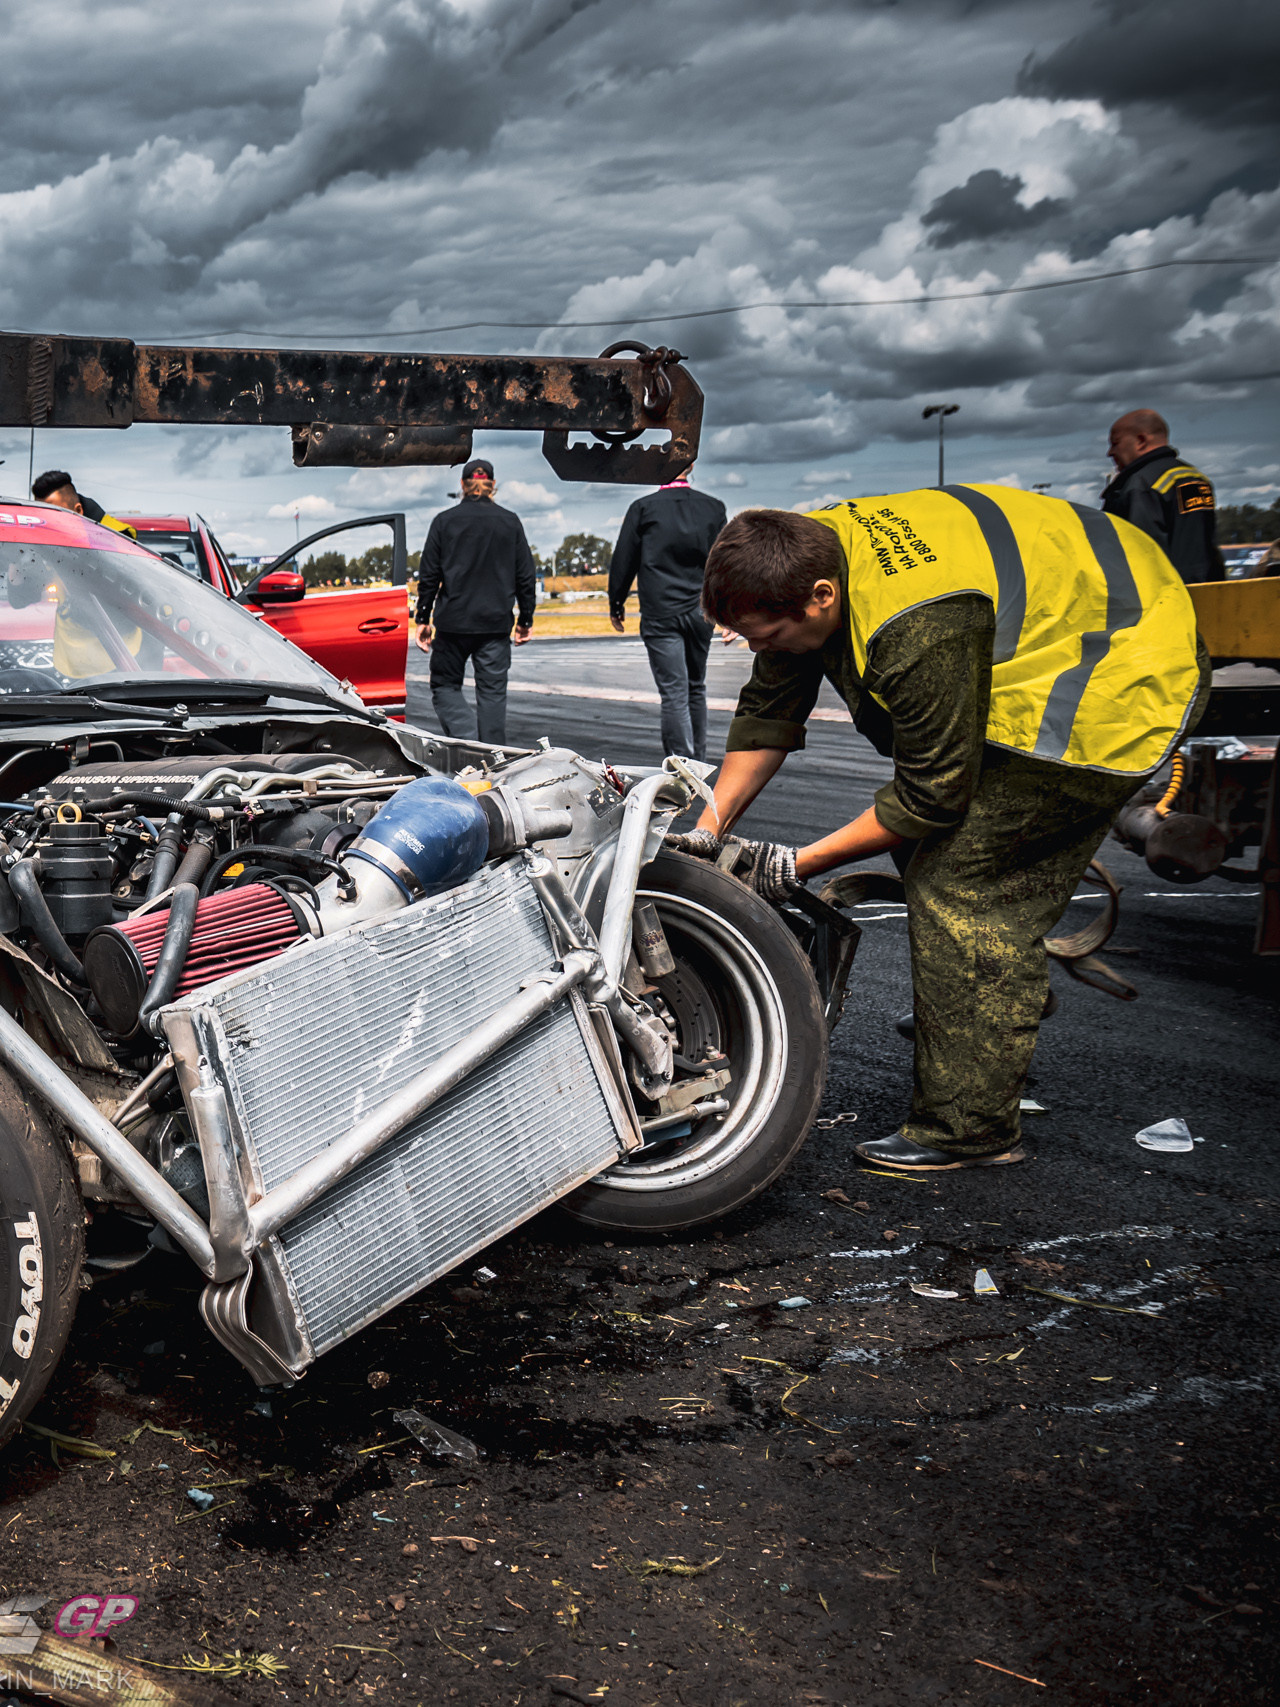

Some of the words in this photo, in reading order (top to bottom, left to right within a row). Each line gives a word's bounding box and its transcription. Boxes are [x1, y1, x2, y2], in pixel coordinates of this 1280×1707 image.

[897, 519, 917, 540] 555
[909, 539, 931, 556] 800
[923, 555, 938, 563] 8
[51, 775, 117, 785] MAGNUSON
[12, 1211, 44, 1360] TOYO
